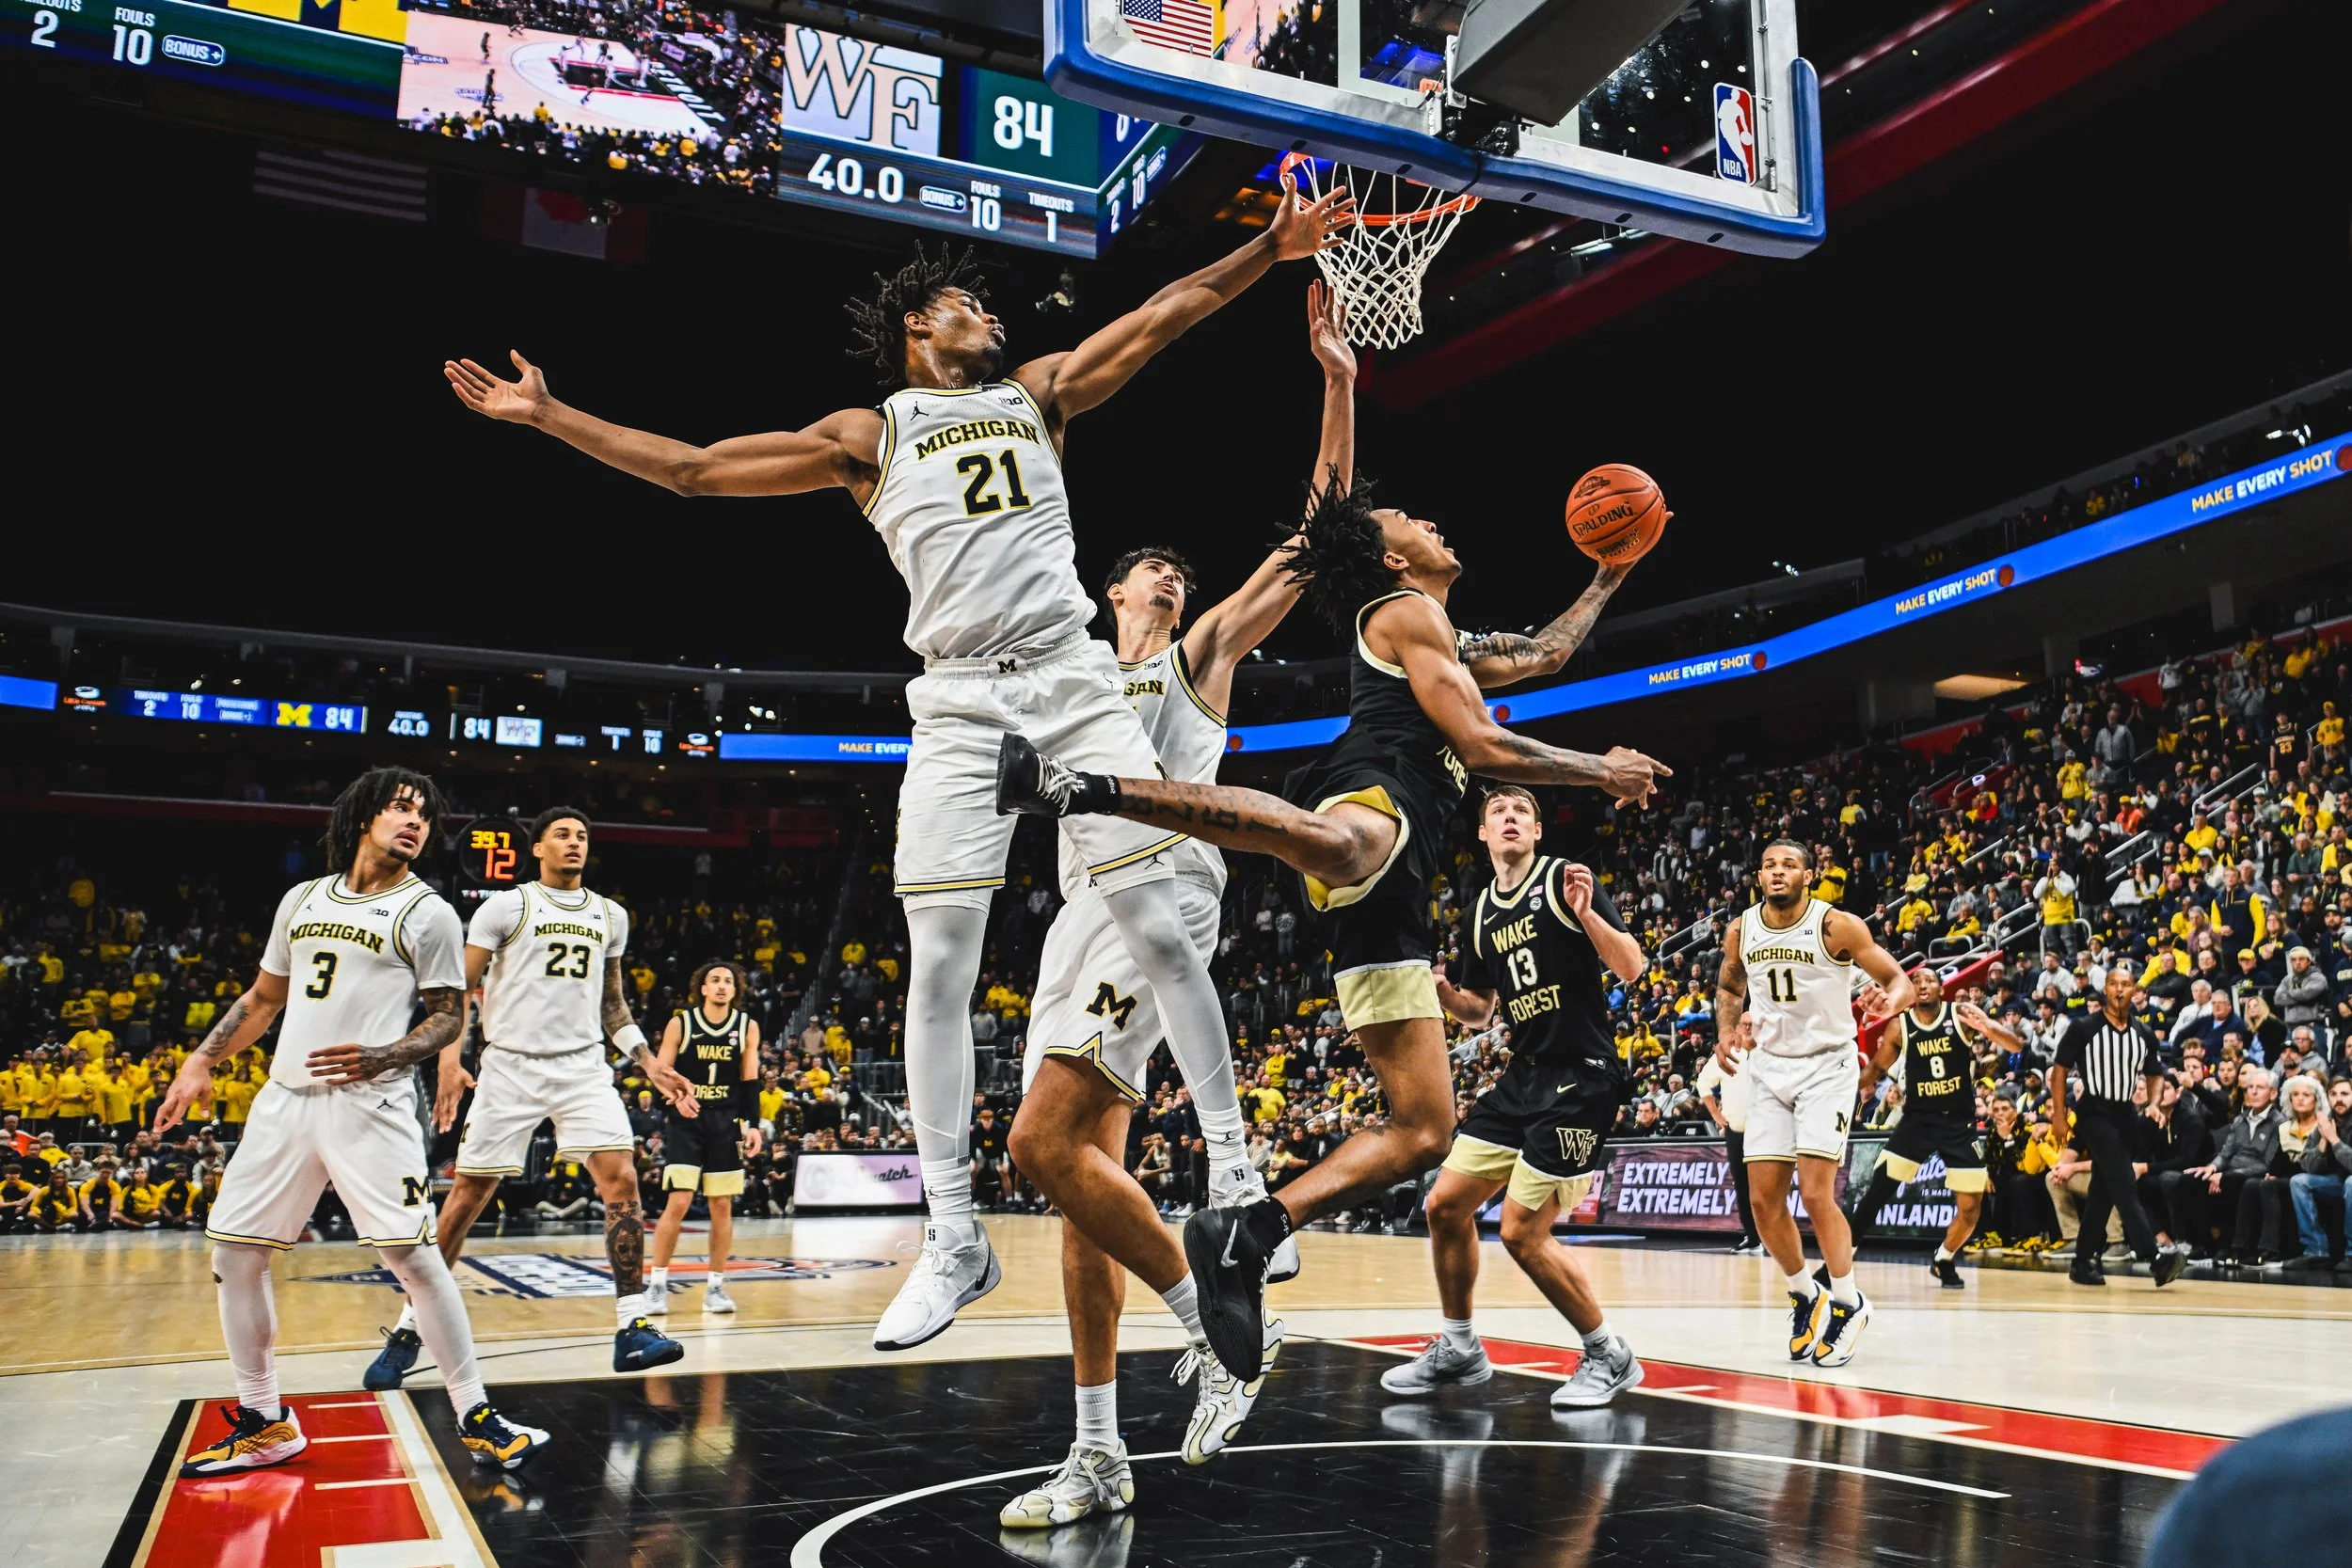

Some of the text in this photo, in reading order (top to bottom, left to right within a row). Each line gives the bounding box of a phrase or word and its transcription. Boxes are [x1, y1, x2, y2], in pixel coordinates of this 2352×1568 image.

[31, 9, 59, 48] 2
[115, 7, 155, 27] FOULS
[112, 24, 152, 66] 10
[165, 39, 209, 60] BONUS
[993, 96, 1054, 157] 84
[807, 153, 904, 204] 40.0
[1723, 158, 1742, 178] NBA
[922, 190, 956, 209] BONUS
[970, 180, 1001, 197] FOULS
[1028, 192, 1074, 214] TIMEOUTS
[1132, 170, 1146, 210] 10
[971, 196, 1001, 232] 10
[1045, 211, 1057, 243] 1
[1111, 199, 1120, 234] 2
[914, 420, 1041, 461] MICHIGAN
[956, 448, 1033, 517] 21
[2192, 450, 2333, 513] MAKE EVERY SHOT
[1896, 568, 1996, 615] MAKE EVERY SHOT
[996, 658, 1018, 673] M
[1648, 654, 1751, 685] MAKE EVERY SHOT
[144, 700, 157, 717] 2
[182, 703, 201, 720] 10
[277, 703, 313, 727] M
[325, 706, 355, 730] 84
[388, 718, 430, 737] 40.0
[464, 717, 492, 740] 84
[644, 736, 661, 753] 10
[838, 742, 914, 754] MAKE EVERY
[470, 831, 510, 848] 39.7
[485, 848, 516, 879] 12
[290, 922, 385, 954] MICHIGAN
[533, 922, 604, 944] MICHIGAN
[1491, 913, 1537, 954] WAKE
[545, 942, 591, 980] 23
[1507, 947, 1538, 991] 13
[1746, 948, 1815, 965] MICHIGAN
[305, 951, 338, 1000] 3
[1766, 968, 1798, 1003] 11
[1085, 980, 1138, 1032] M
[1508, 985, 1561, 1024] FOREST
[696, 1045, 734, 1061] WAKE
[1916, 1037, 1952, 1056] WAKE
[708, 1062, 718, 1085] 1
[1930, 1055, 1946, 1079] 8
[694, 1085, 730, 1100] OREST
[1917, 1076, 1962, 1097] FOREST
[1555, 1127, 1598, 1167] WF
[1622, 1162, 1731, 1185] EXTREMELY
[402, 1176, 433, 1208] M
[1616, 1188, 1737, 1216] EXTREMELY
